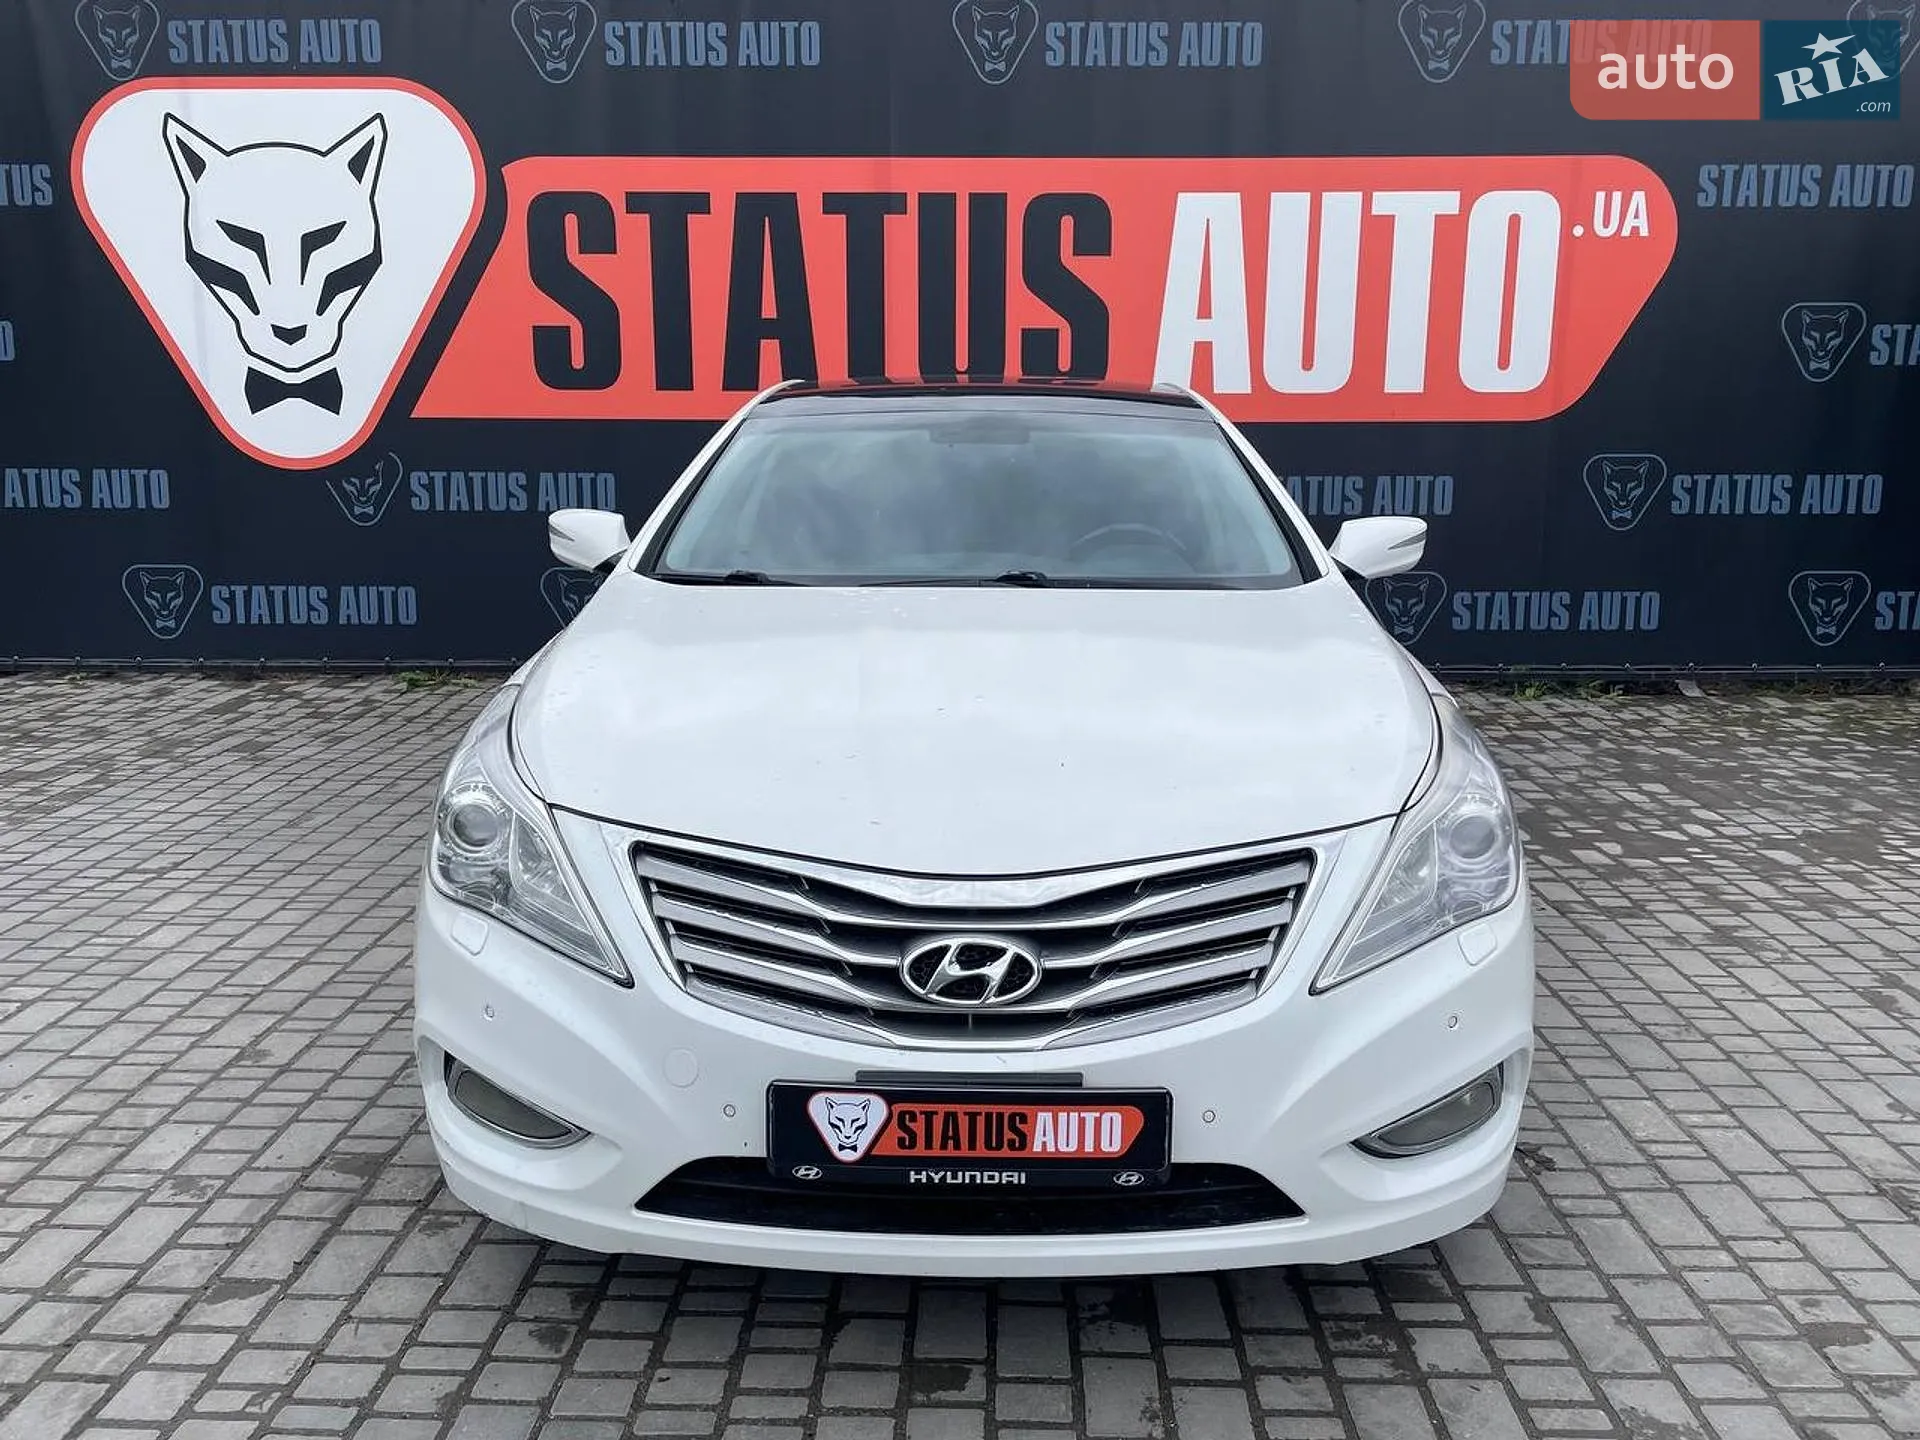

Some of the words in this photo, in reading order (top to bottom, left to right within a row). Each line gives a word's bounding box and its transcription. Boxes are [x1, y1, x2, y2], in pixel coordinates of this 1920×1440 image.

[168, 19, 289, 63] STATUS
[299, 19, 382, 63] AUTO
[604, 21, 727, 66] STATUS
[738, 22, 820, 66] AUTO
[1045, 22, 1168, 66] STATUS
[1178, 22, 1263, 66] AUTO
[1697, 164, 1822, 207] STATUS
[1829, 165, 1914, 207] AUTO
[526, 191, 1112, 391] STATUS
[1151, 190, 1562, 395] AUTO
[1572, 190, 1649, 237] .UA
[91, 469, 170, 509] AUTO
[410, 471, 528, 512] STATUS
[538, 472, 616, 512] AUTO
[1285, 475, 1363, 516] ATUS
[1372, 475, 1454, 516] AUTO
[1670, 474, 1793, 515] STATUS
[1800, 475, 1883, 515] AUTO
[212, 584, 328, 626] STATUS
[339, 586, 417, 626] AUTO
[1451, 592, 1569, 631] STATUS
[1578, 592, 1661, 630] AUTO
[896, 1110, 1029, 1151] STATUS
[1033, 1111, 1123, 1152] AUTO
[909, 1170, 1027, 1185] HYUNDAI
